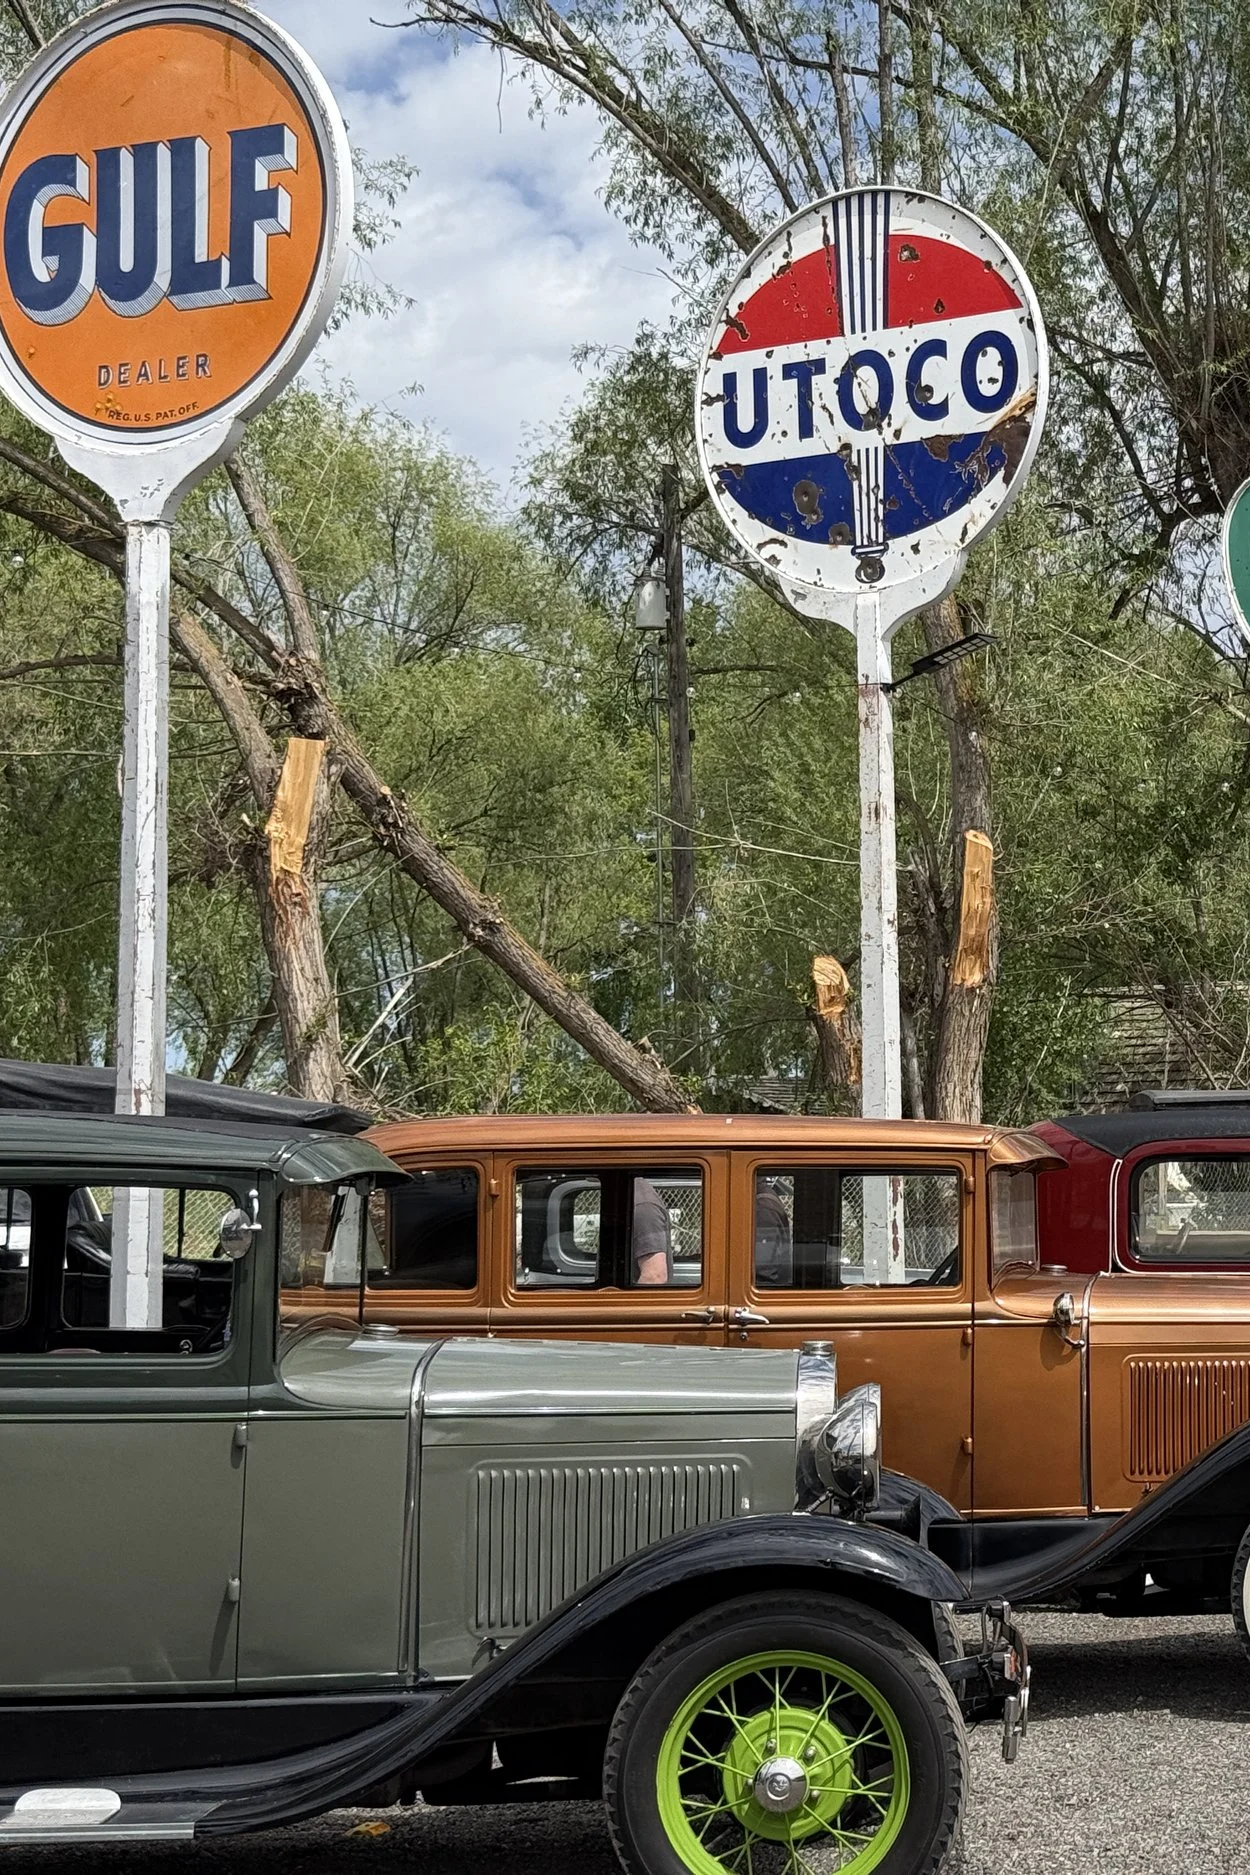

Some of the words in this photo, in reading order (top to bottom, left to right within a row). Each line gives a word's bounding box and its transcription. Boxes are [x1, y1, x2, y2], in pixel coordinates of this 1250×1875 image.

[3, 123, 299, 328] GULF
[97, 353, 212, 390] DEALER
[721, 329, 1019, 450] UTOCO
[107, 410, 132, 422] REG.
[155, 409, 177, 421] PAT.
[178, 401, 200, 416] OFF.
